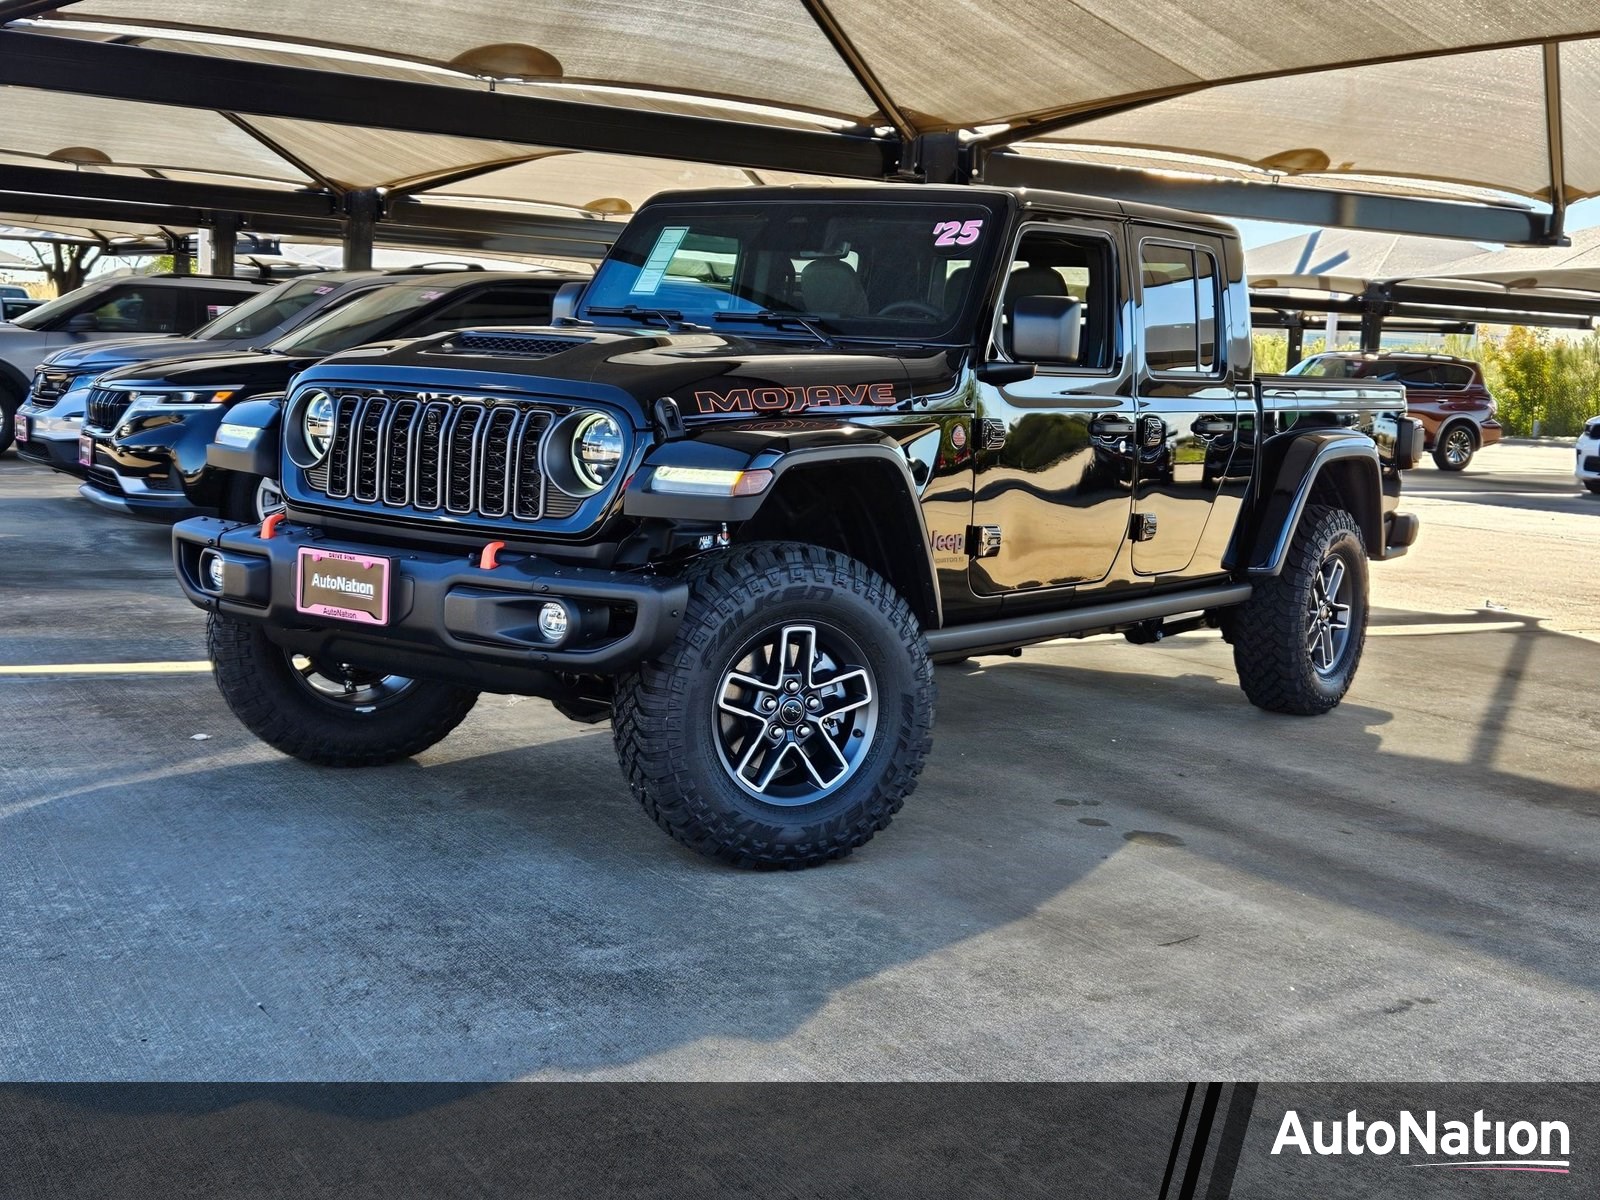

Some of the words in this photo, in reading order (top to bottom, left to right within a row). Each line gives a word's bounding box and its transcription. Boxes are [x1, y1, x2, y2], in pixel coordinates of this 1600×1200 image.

[933, 219, 983, 246] '25
[694, 383, 896, 413] MOJAVE
[931, 529, 964, 554] Jeep
[311, 572, 374, 596] AutoNation
[322, 607, 357, 619] AutoNation
[700, 585, 834, 671] FALKEN
